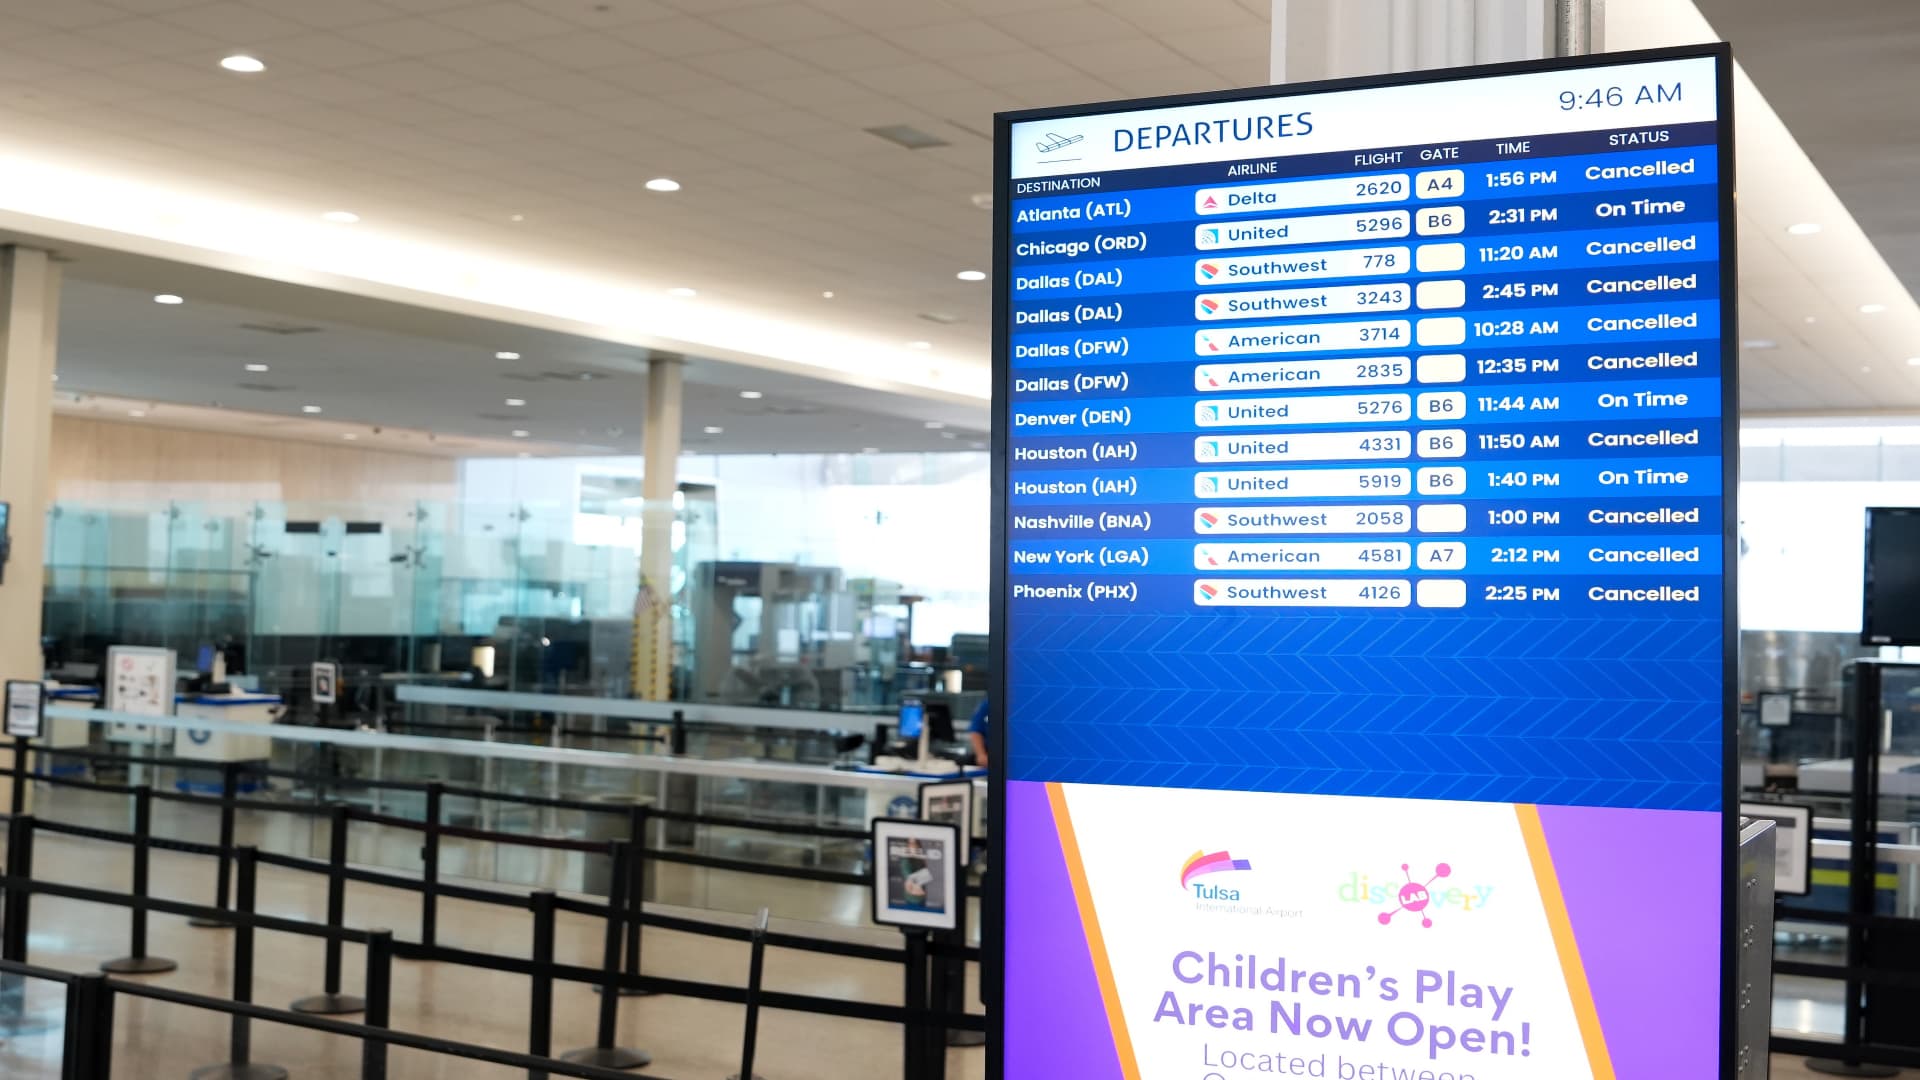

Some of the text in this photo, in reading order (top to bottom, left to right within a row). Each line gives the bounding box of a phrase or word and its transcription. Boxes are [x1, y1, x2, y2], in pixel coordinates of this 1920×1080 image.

[1559, 82, 1683, 111] 9:46 AM
[1113, 111, 1314, 153] DEPARTURES
[1016, 130, 1670, 194] DESTINATION AIRLINE FLIGHT GATE TIME STATUS
[1017, 158, 1695, 223] Atlanta (ATL) Delta 2620 A4 1:56 PM Cancelled
[1016, 198, 1686, 257] Chicago (ORD) United 5296 B6 2:31 PM On Time
[1016, 235, 1696, 290] Dallas (DAL) Southwest 778 11:20 AM Cancelled
[1016, 273, 1697, 324] Dallas (DAL) Southwest 3243 2:45 PM Cancelled
[1015, 312, 1697, 358] Dallas (DFW) American 3714 10:28 AM Cancelled
[1015, 351, 1698, 393] Dallas (DFW) American 2835 12:35 PM Cancelled
[1015, 390, 1688, 427] Denver (DEN) United 5276 B6 11:44 AM On Time
[1014, 429, 1699, 462] Houston (IAH) United 4331 B6 11:50 AM Cancelled
[1014, 468, 1689, 497] Houston (IAH) United 5919 B6 1:40 PM On Time
[1014, 507, 1699, 532] Nashville (BNA) Southwest 2058 1:00 PM Cancelled
[1014, 546, 1699, 567] New York (LGA) American 4581 A7 2:12 PM Cancelled
[1013, 581, 1699, 602] Phoenix (PHX) Southwest 4126 2:25 PM Cancelled
[1193, 883, 1240, 901] Tulsa
[1401, 890, 1427, 905] LAB
[1415, 968, 1514, 1022] Play
[1152, 990, 1531, 1060] Area Now Open!
[1203, 1042, 1325, 1078] Located
